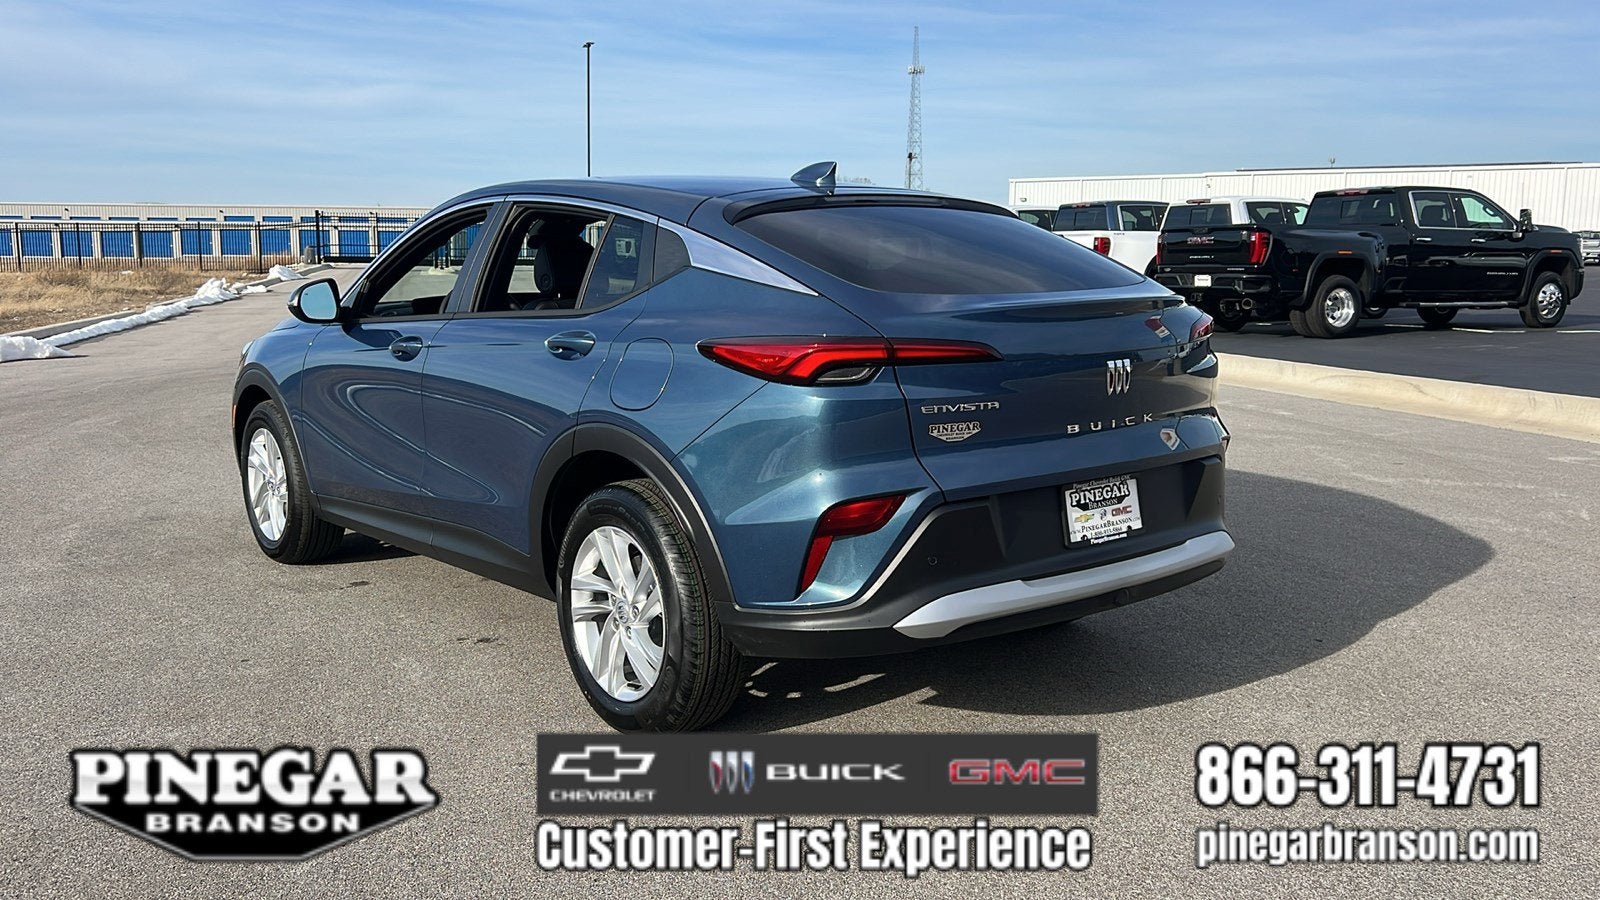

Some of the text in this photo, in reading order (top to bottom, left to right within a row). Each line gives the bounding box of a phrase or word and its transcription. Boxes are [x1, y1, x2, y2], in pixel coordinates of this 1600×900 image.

[921, 401, 1000, 414] ENVISTA
[929, 422, 980, 434] PINEGAR
[1066, 413, 1153, 435] BUICK
[1070, 483, 1130, 506] PINEGAR
[1088, 498, 1118, 510] BRANSON
[1111, 505, 1132, 517] GMC
